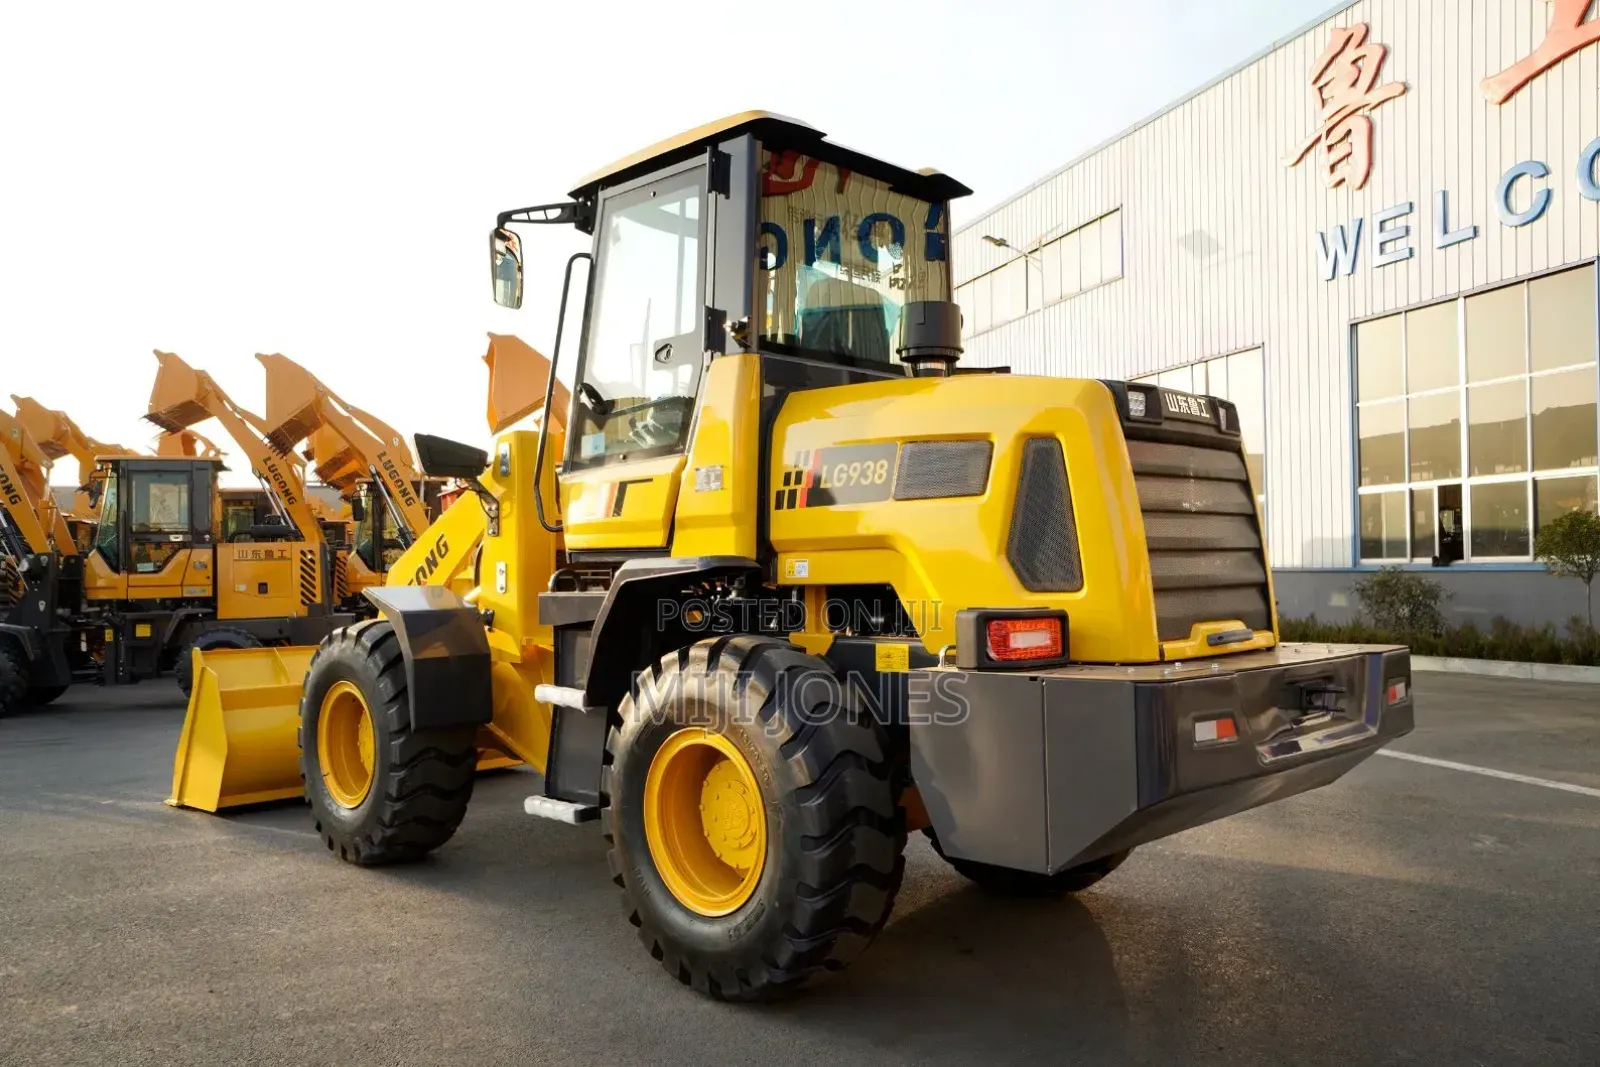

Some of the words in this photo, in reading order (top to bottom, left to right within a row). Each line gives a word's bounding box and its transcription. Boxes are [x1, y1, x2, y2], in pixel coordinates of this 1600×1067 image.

[1164, 392, 1210, 418] 山东鲁工
[262, 456, 297, 505] LUGONG
[377, 450, 416, 507] LUGONG
[819, 459, 889, 489] LG938
